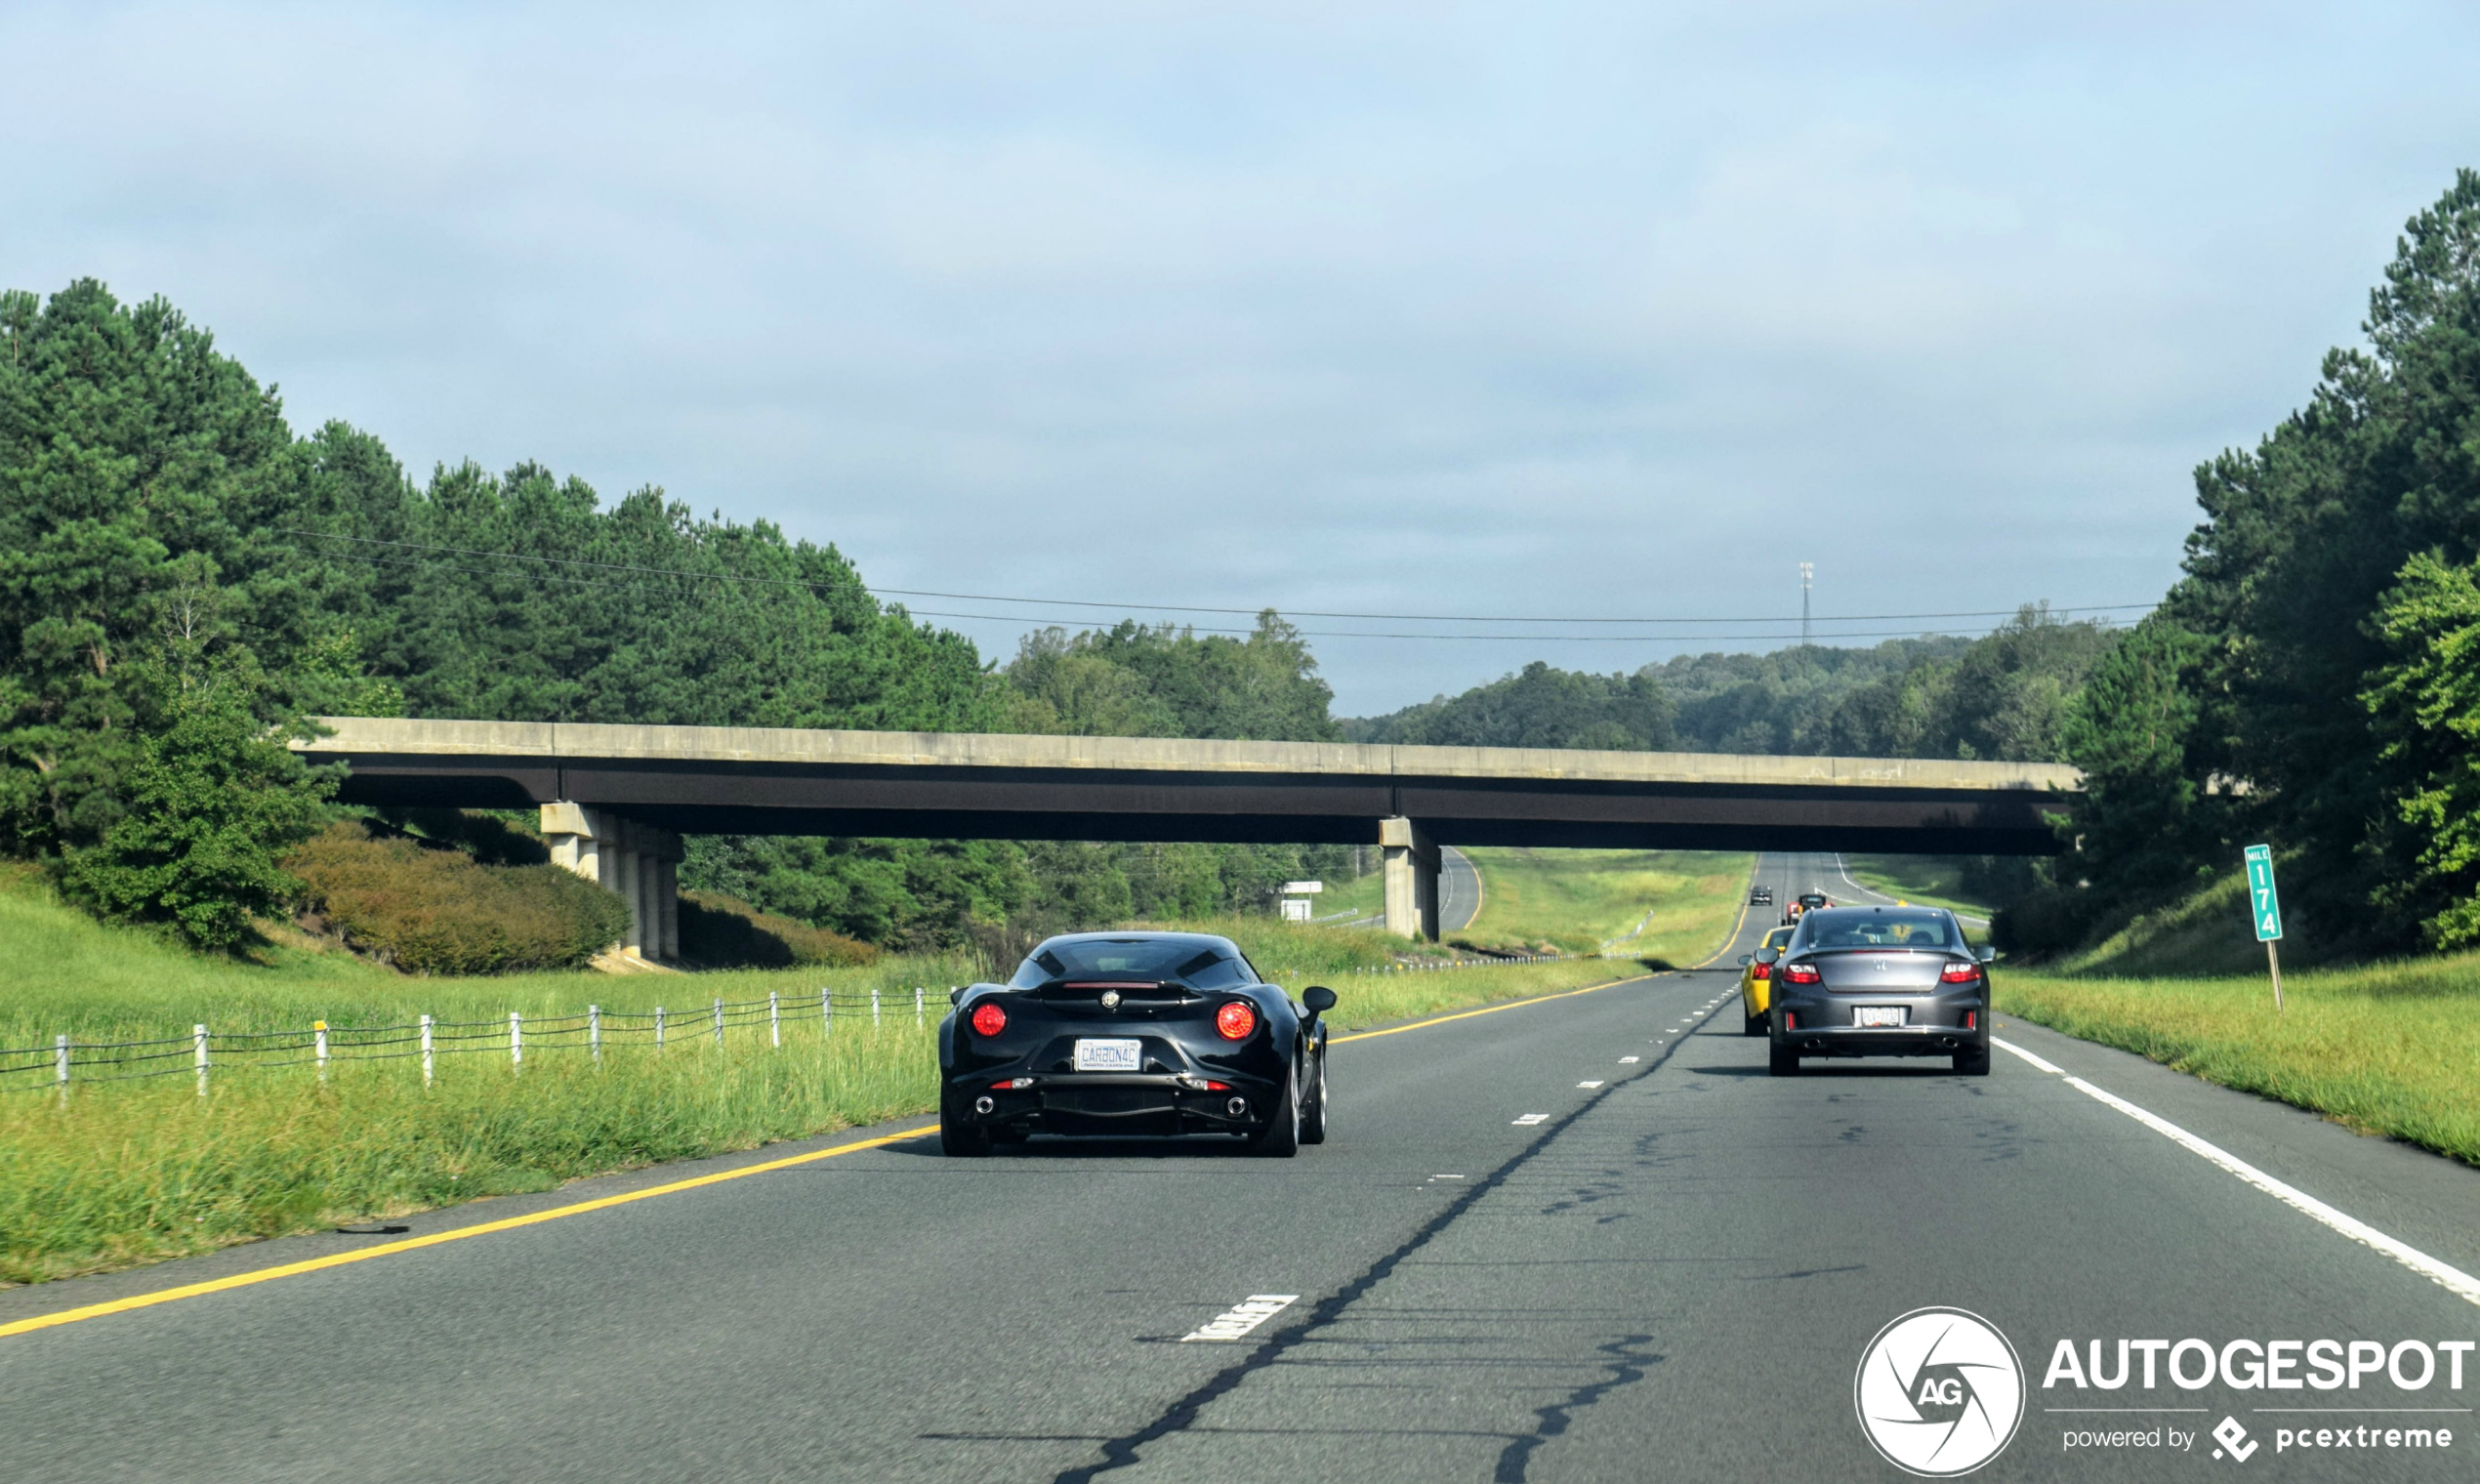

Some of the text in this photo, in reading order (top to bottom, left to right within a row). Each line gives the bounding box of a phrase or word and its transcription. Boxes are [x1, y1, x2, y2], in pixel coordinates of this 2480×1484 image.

[2248, 849, 2269, 861] MILE
[2256, 864, 2276, 934] 174
[1082, 1047, 1136, 1063] CARBON4C
